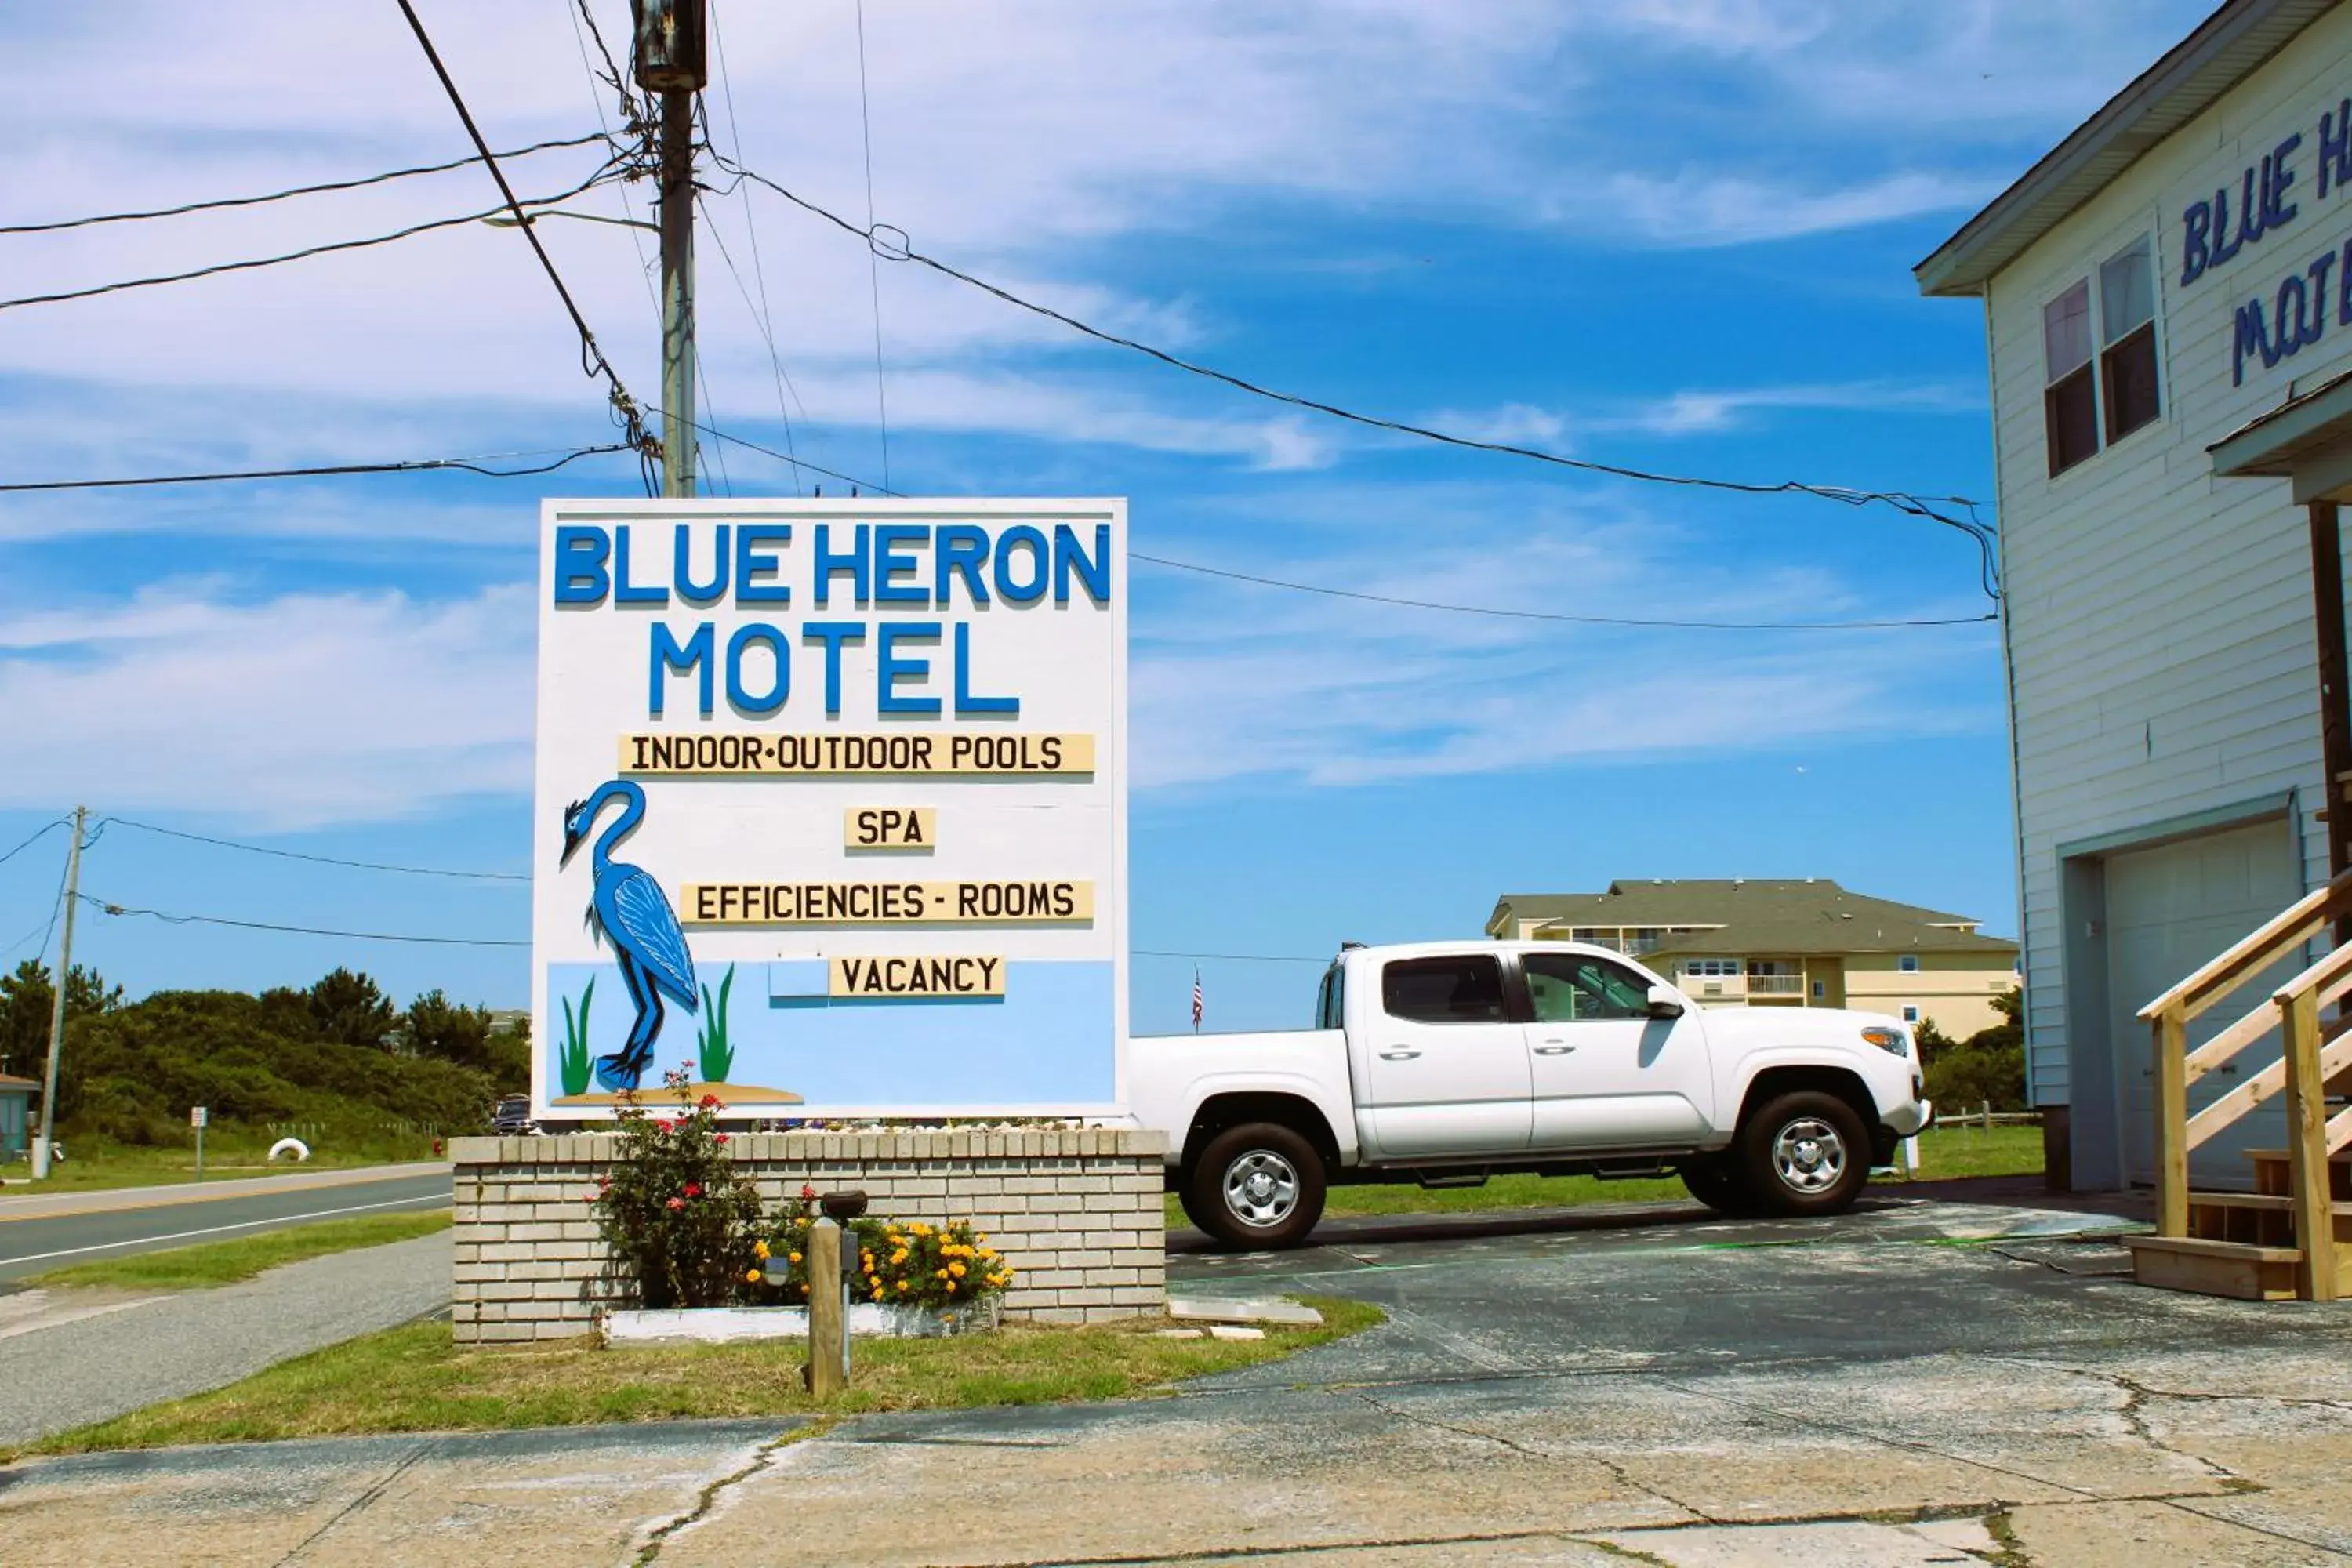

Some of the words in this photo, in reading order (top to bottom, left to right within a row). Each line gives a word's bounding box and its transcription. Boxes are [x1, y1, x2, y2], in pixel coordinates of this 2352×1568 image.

[2180, 132, 2301, 287] BLUE
[554, 524, 791, 604] BLUE
[814, 524, 1110, 604] HERON
[649, 622, 1020, 714] MOTEL
[951, 735, 1062, 770] POOLS
[858, 810, 924, 844] SPA
[697, 884, 924, 920] EFFICIENCIES
[958, 883, 1074, 917] ROOMS
[841, 957, 999, 993] VACANCY
